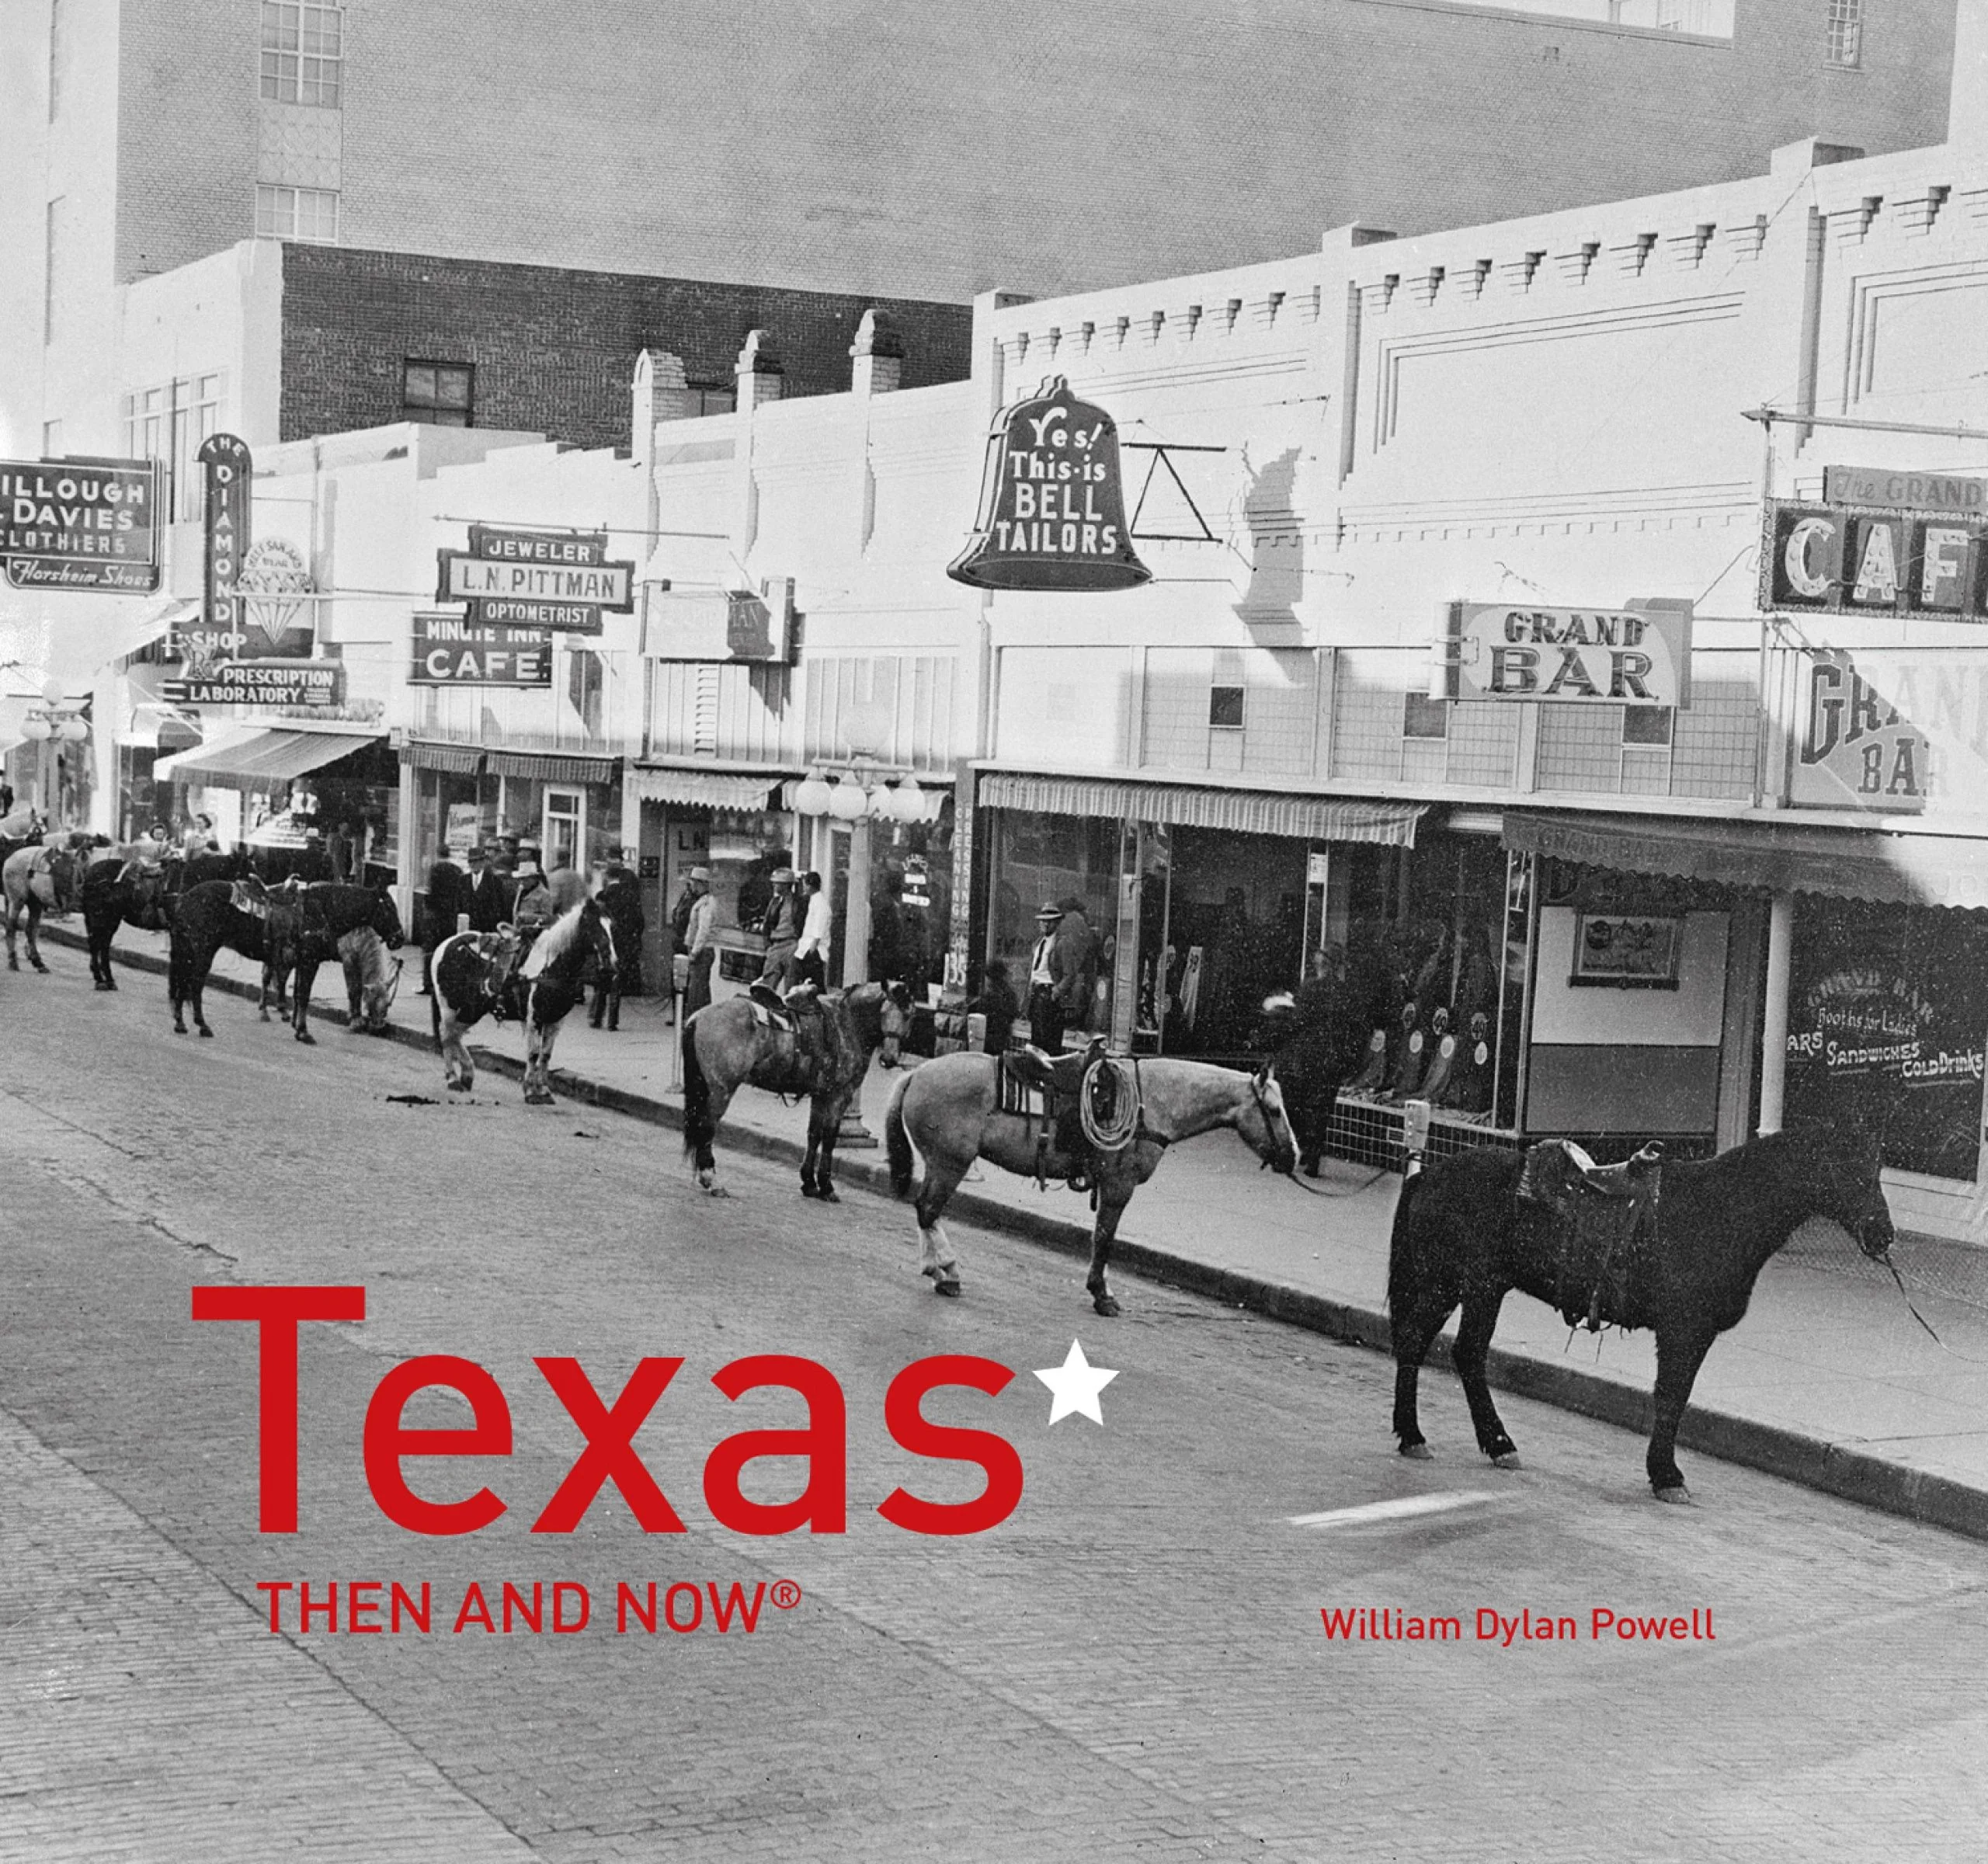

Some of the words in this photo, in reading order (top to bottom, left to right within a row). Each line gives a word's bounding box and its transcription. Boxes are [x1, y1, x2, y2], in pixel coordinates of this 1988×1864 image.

[1029, 406, 1103, 450] Yes!
[206, 436, 245, 457] THE
[2, 475, 144, 503] ILLOUGH
[1015, 482, 1103, 522] BELL
[1885, 475, 1982, 506] GRAND
[13, 498, 134, 531] DAVIES
[215, 464, 234, 621] DIAMOND
[488, 539, 591, 562] JEWELER
[996, 520, 1117, 555] TAILORS
[12, 559, 98, 584] Florsheim
[99, 565, 154, 586] Shoes
[1785, 516, 1988, 603] CAF
[511, 568, 615, 598] PITTMAN
[486, 602, 590, 624] OPTOMETRIST
[191, 630, 248, 650] SHOP
[1503, 611, 1646, 647] GRAND
[223, 668, 335, 687] PRESCRIPTION
[1485, 644, 1660, 701] BAR
[189, 686, 301, 703] LABORATORY
